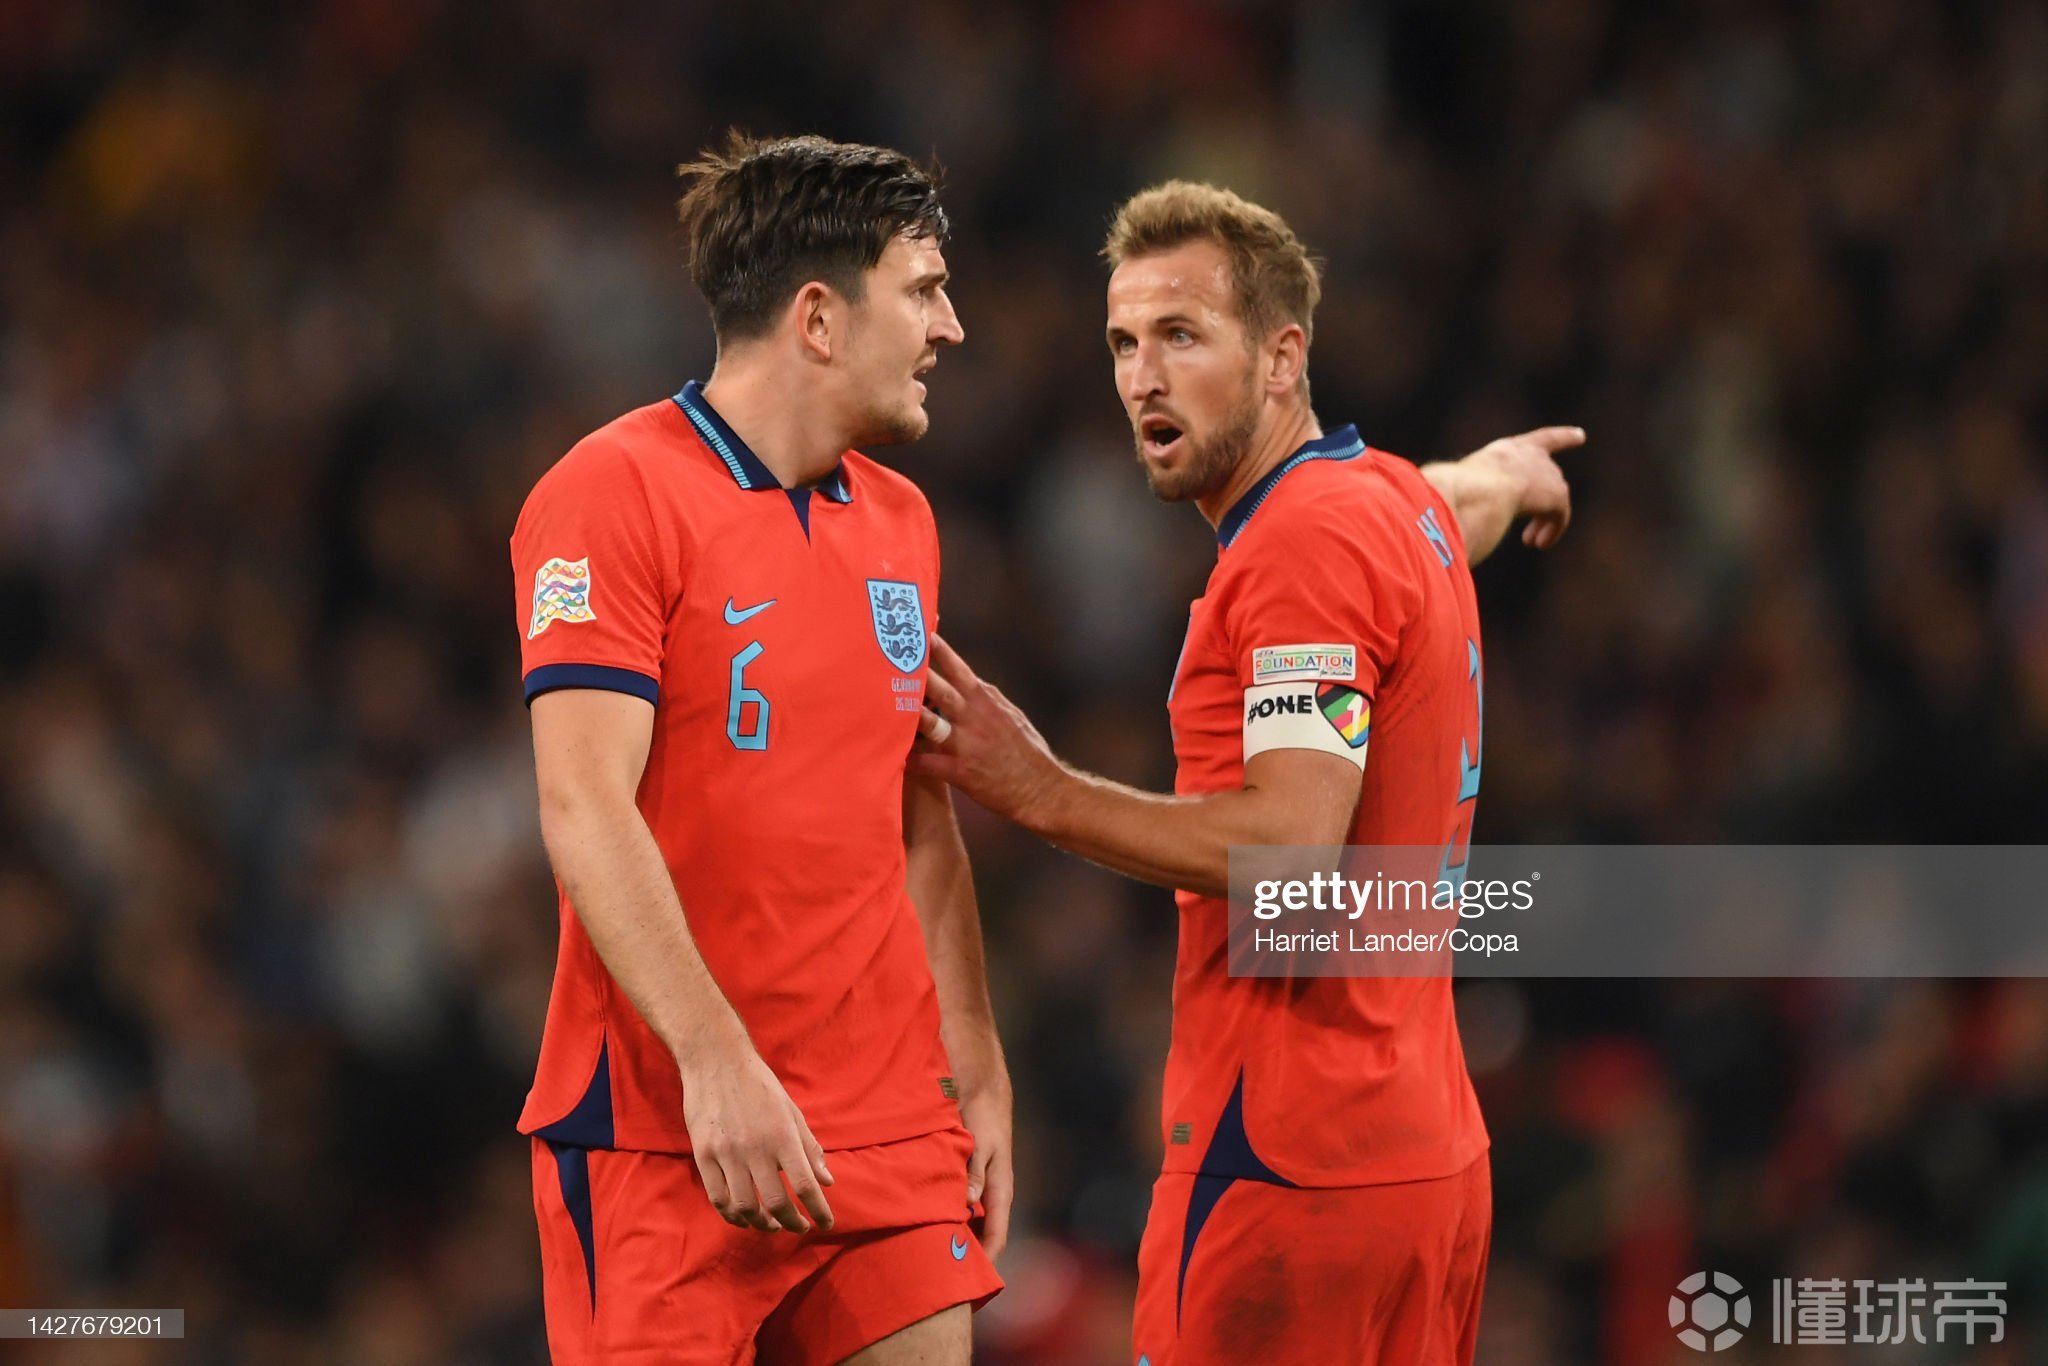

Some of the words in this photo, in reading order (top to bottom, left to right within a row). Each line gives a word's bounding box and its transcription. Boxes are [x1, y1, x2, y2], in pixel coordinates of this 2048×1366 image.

[1256, 655, 1353, 672] FOUNDATION
[726, 640, 770, 751] 6
[1247, 694, 1313, 726] #ONE
[1347, 693, 1363, 739] 1
